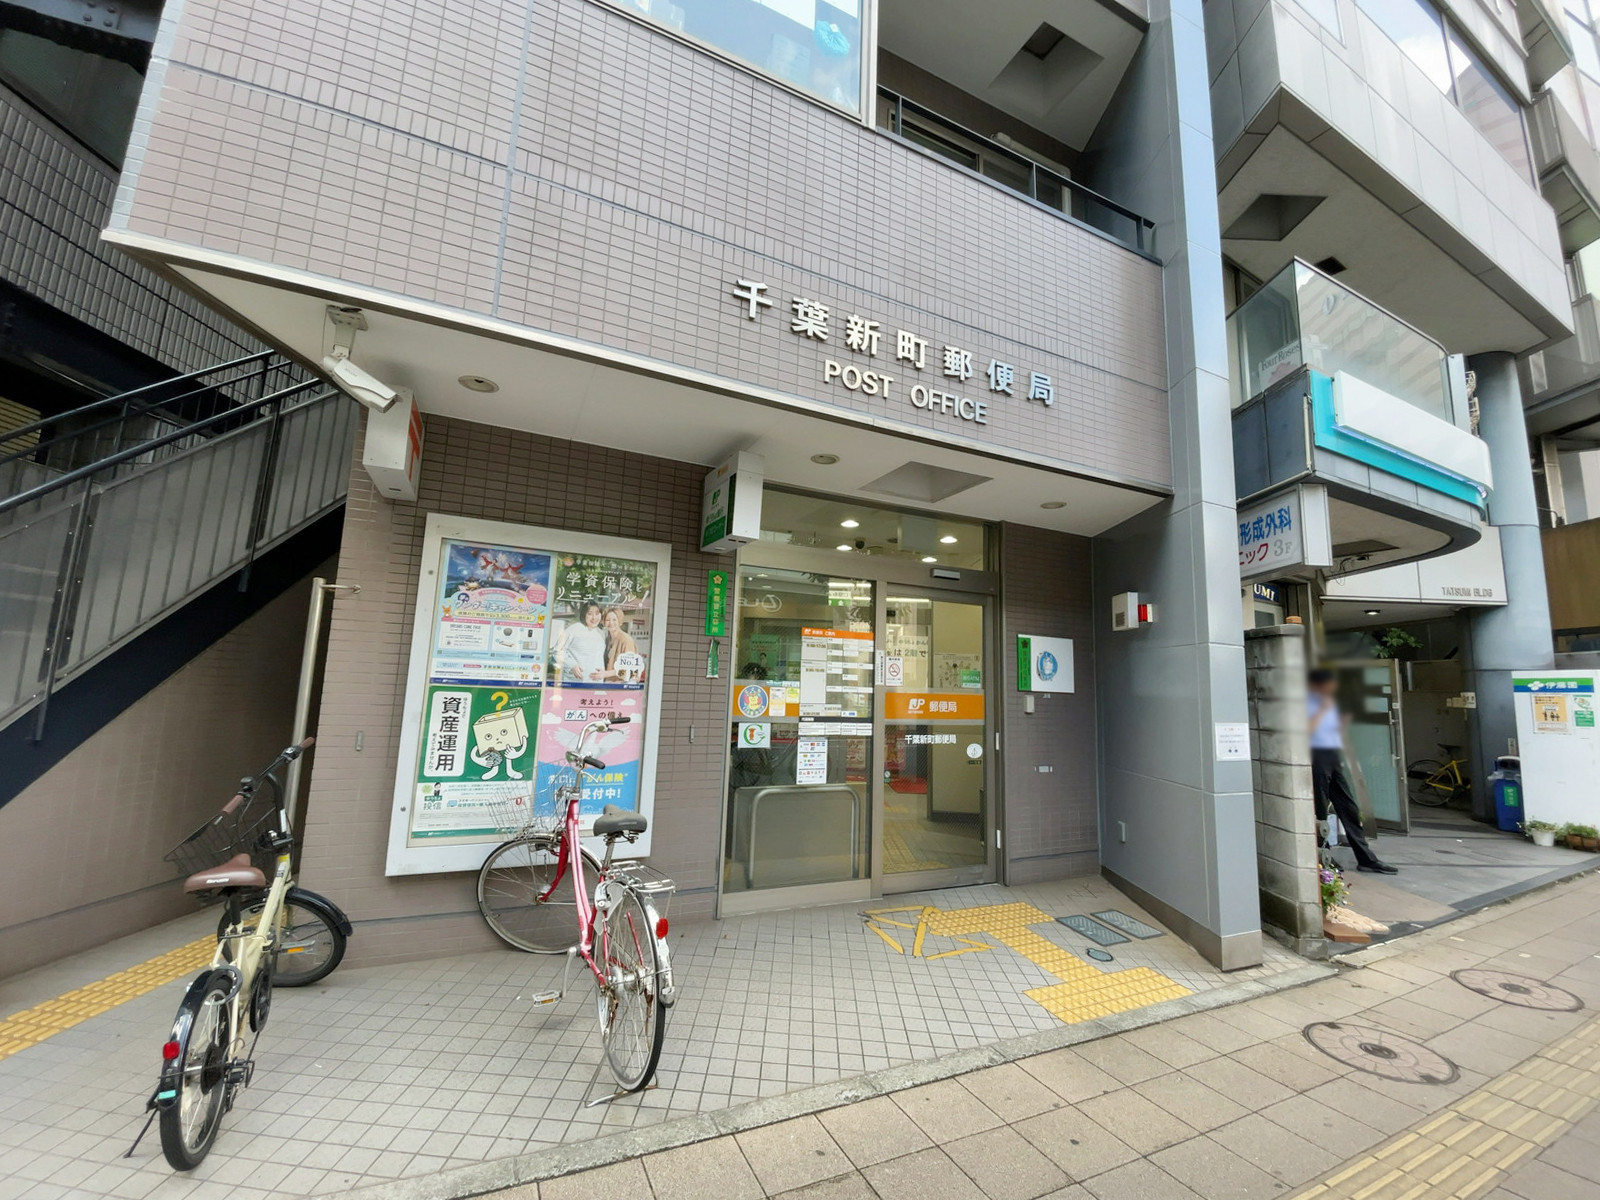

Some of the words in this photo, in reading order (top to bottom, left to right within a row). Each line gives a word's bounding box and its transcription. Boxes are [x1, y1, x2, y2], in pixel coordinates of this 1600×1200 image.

[733, 278, 1055, 407] 千葉新町郵便局
[824, 359, 894, 399] POST
[910, 384, 987, 425] OFFICE
[1240, 505, 1292, 547] 形成外科
[1273, 539, 1293, 557] 3F
[929, 701, 957, 713] 郵便局
[435, 697, 462, 772] 資産運用
[904, 734, 957, 745] 千葉新町郵便局
